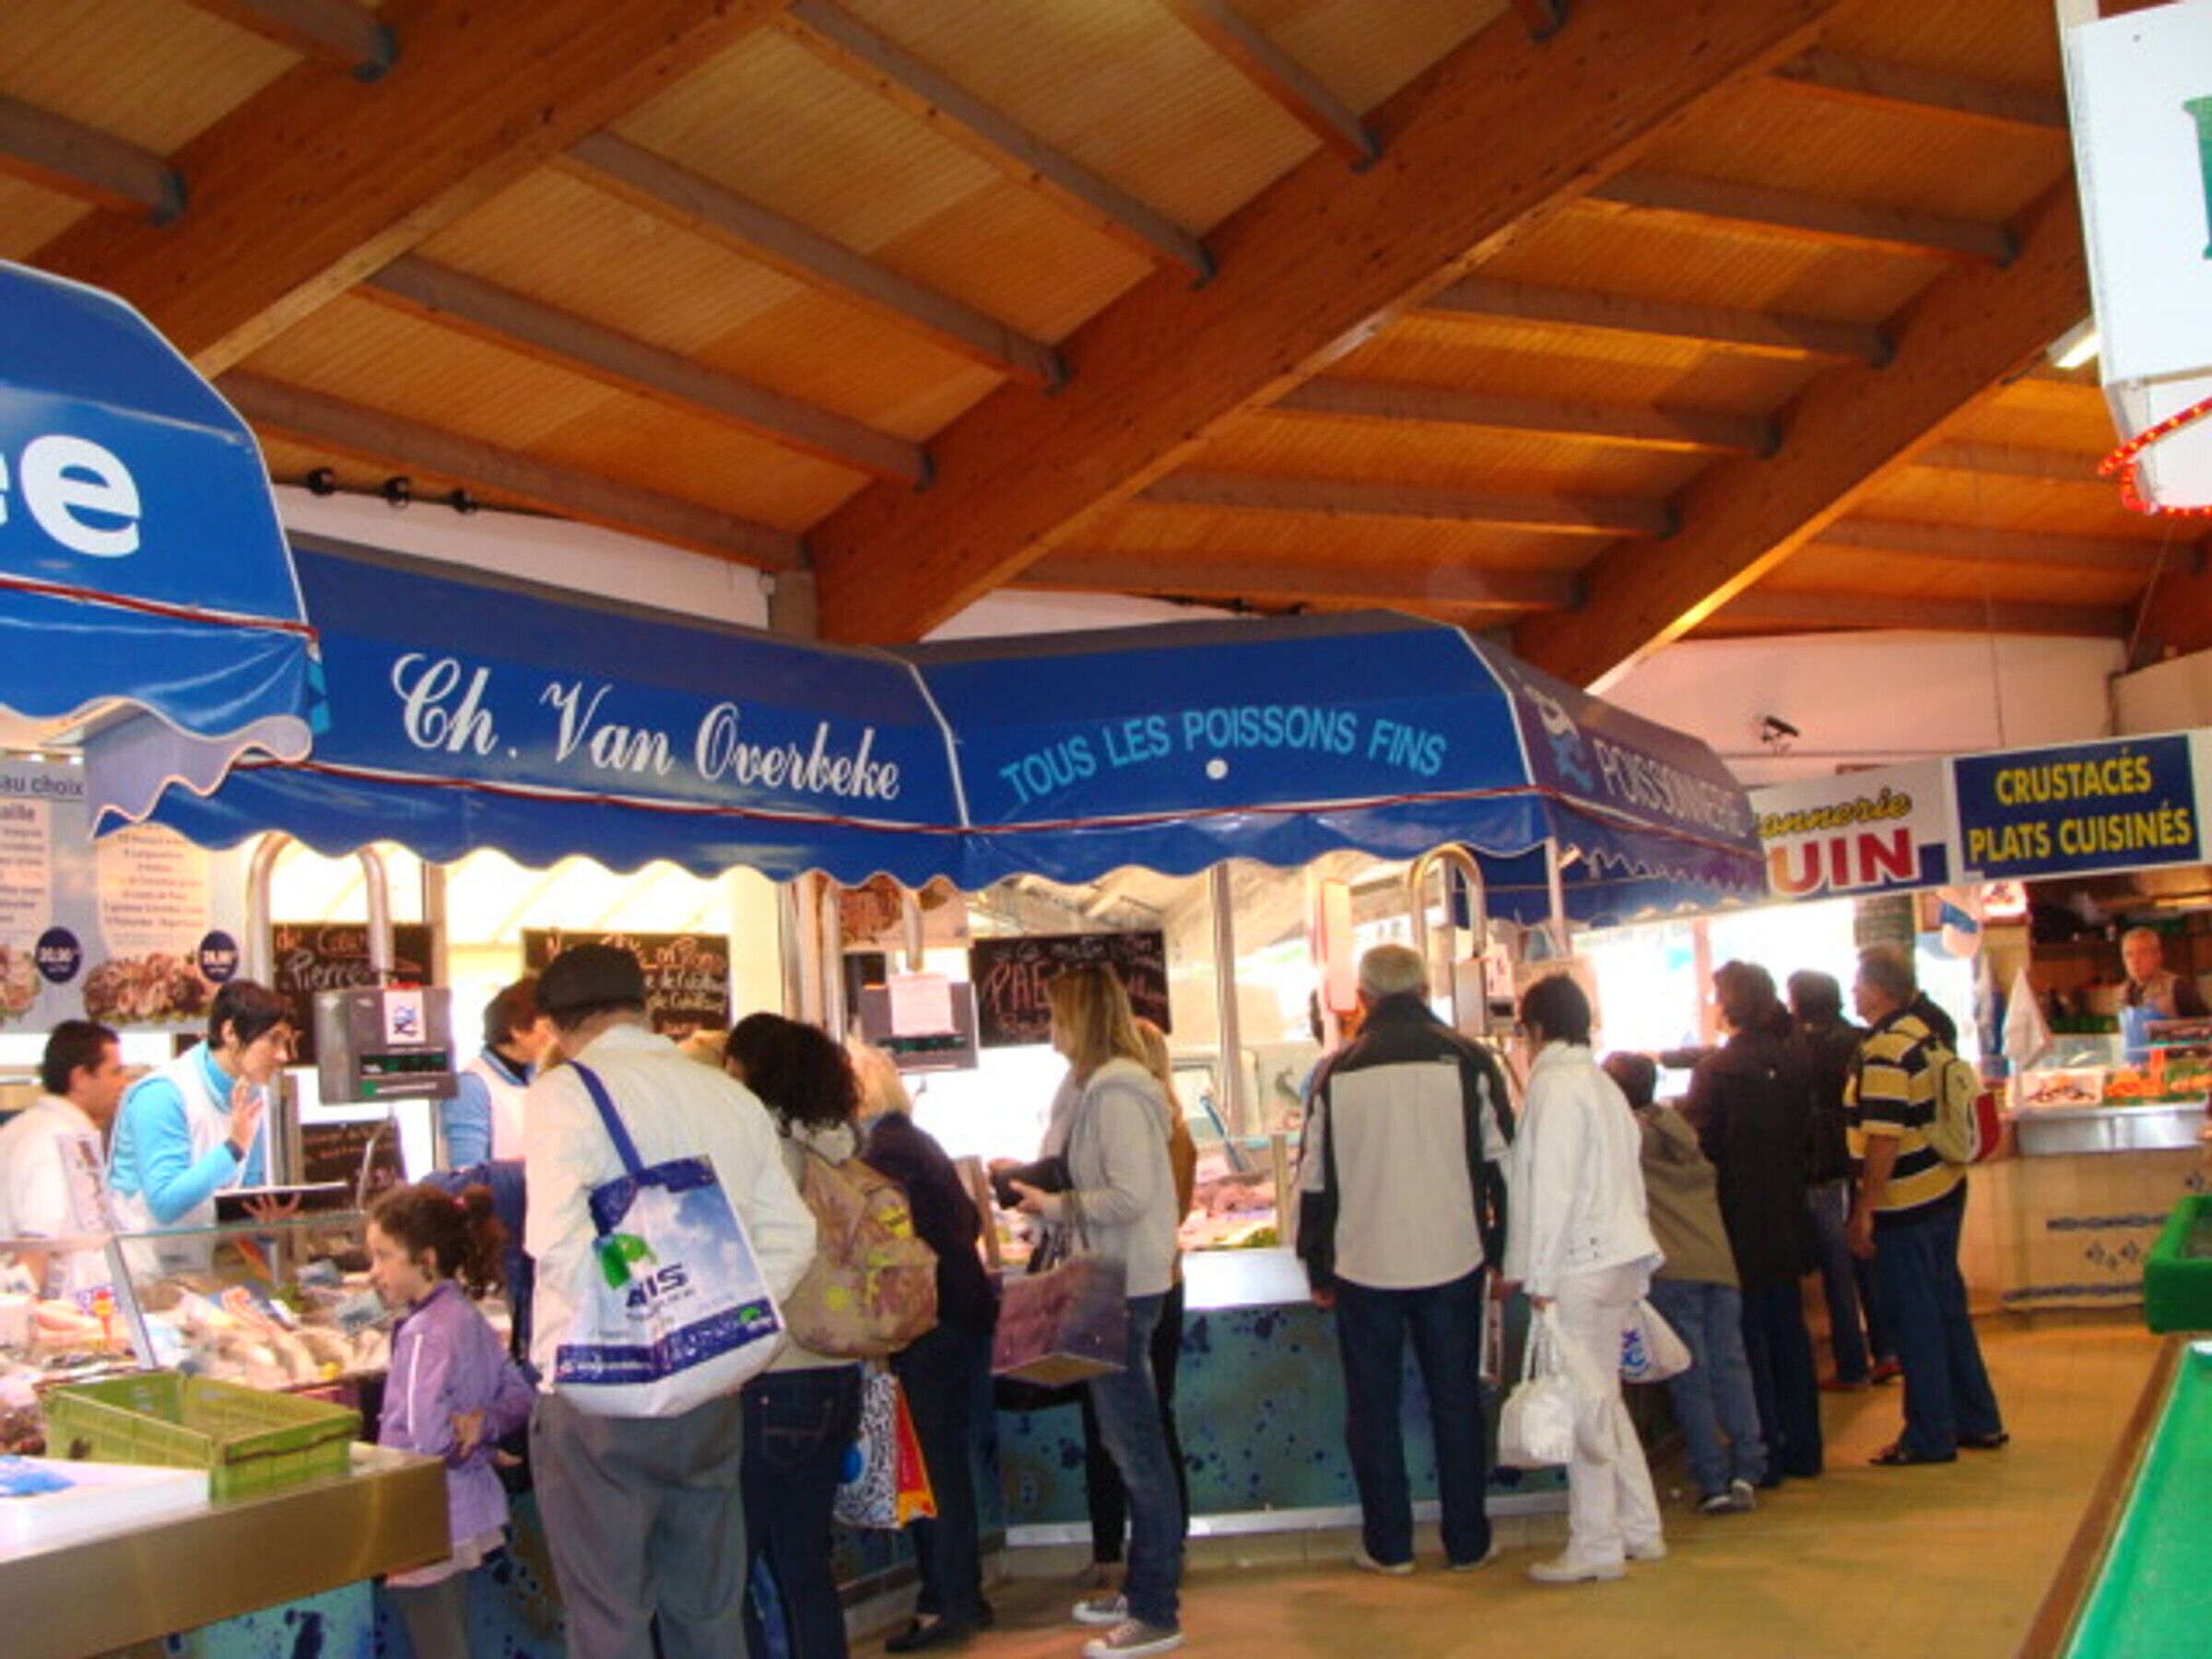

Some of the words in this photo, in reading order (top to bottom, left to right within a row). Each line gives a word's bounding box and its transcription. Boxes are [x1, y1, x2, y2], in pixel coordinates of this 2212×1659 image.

[0, 434, 141, 558] e
[391, 653, 518, 758] Ch.
[539, 680, 677, 776] Van
[694, 702, 900, 801] Overbeke
[1000, 735, 1098, 805] TOUS
[1103, 714, 1171, 769] LES
[1182, 705, 1358, 755] POISSONS
[1366, 719, 1447, 777] FINS
[31, 773, 84, 796] choix
[1995, 747, 2151, 806] CRUSTACÉS
[1969, 821, 2053, 864] PLATS
[2059, 799, 2193, 855] CUISINÉS
